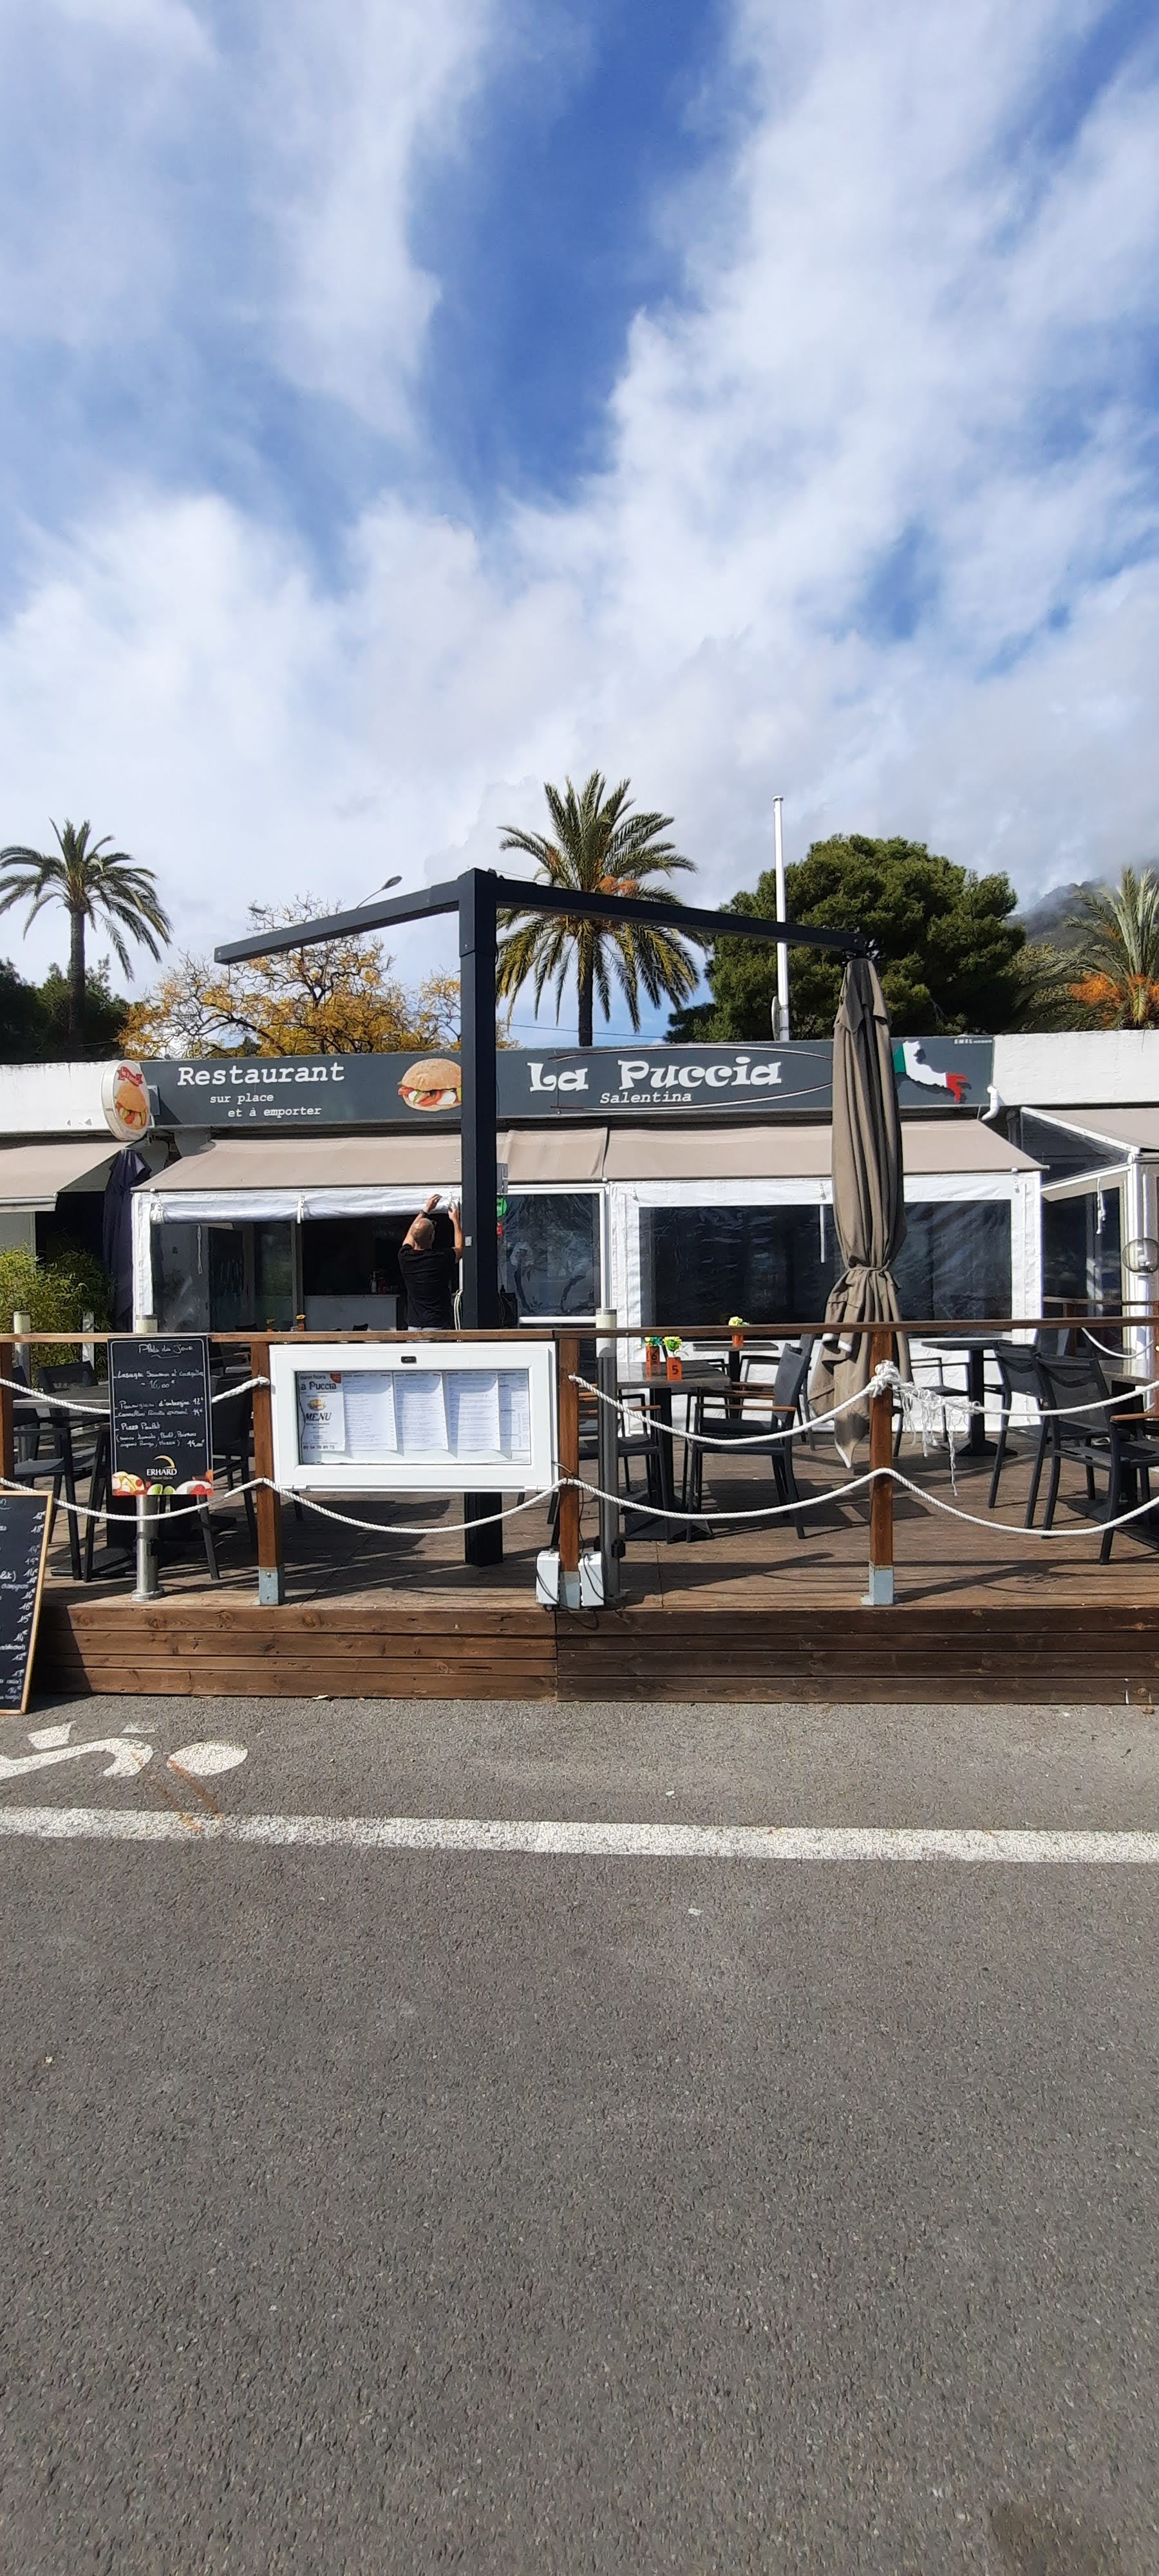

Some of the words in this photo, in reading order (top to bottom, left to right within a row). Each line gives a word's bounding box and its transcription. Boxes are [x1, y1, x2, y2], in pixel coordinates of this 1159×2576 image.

[177, 1062, 345, 1086] Restaurant
[527, 1061, 589, 1092] La
[617, 1056, 783, 1090] Puccia
[210, 1094, 233, 1104] sur
[237, 1093, 274, 1105] place
[599, 1091, 692, 1104] Salentina
[228, 1108, 243, 1117] et
[249, 1107, 257, 1117] à
[264, 1106, 322, 1119] emporter
[672, 1365, 679, 1375] 5
[309, 1381, 337, 1390] Puccia
[305, 1412, 332, 1421] MENU
